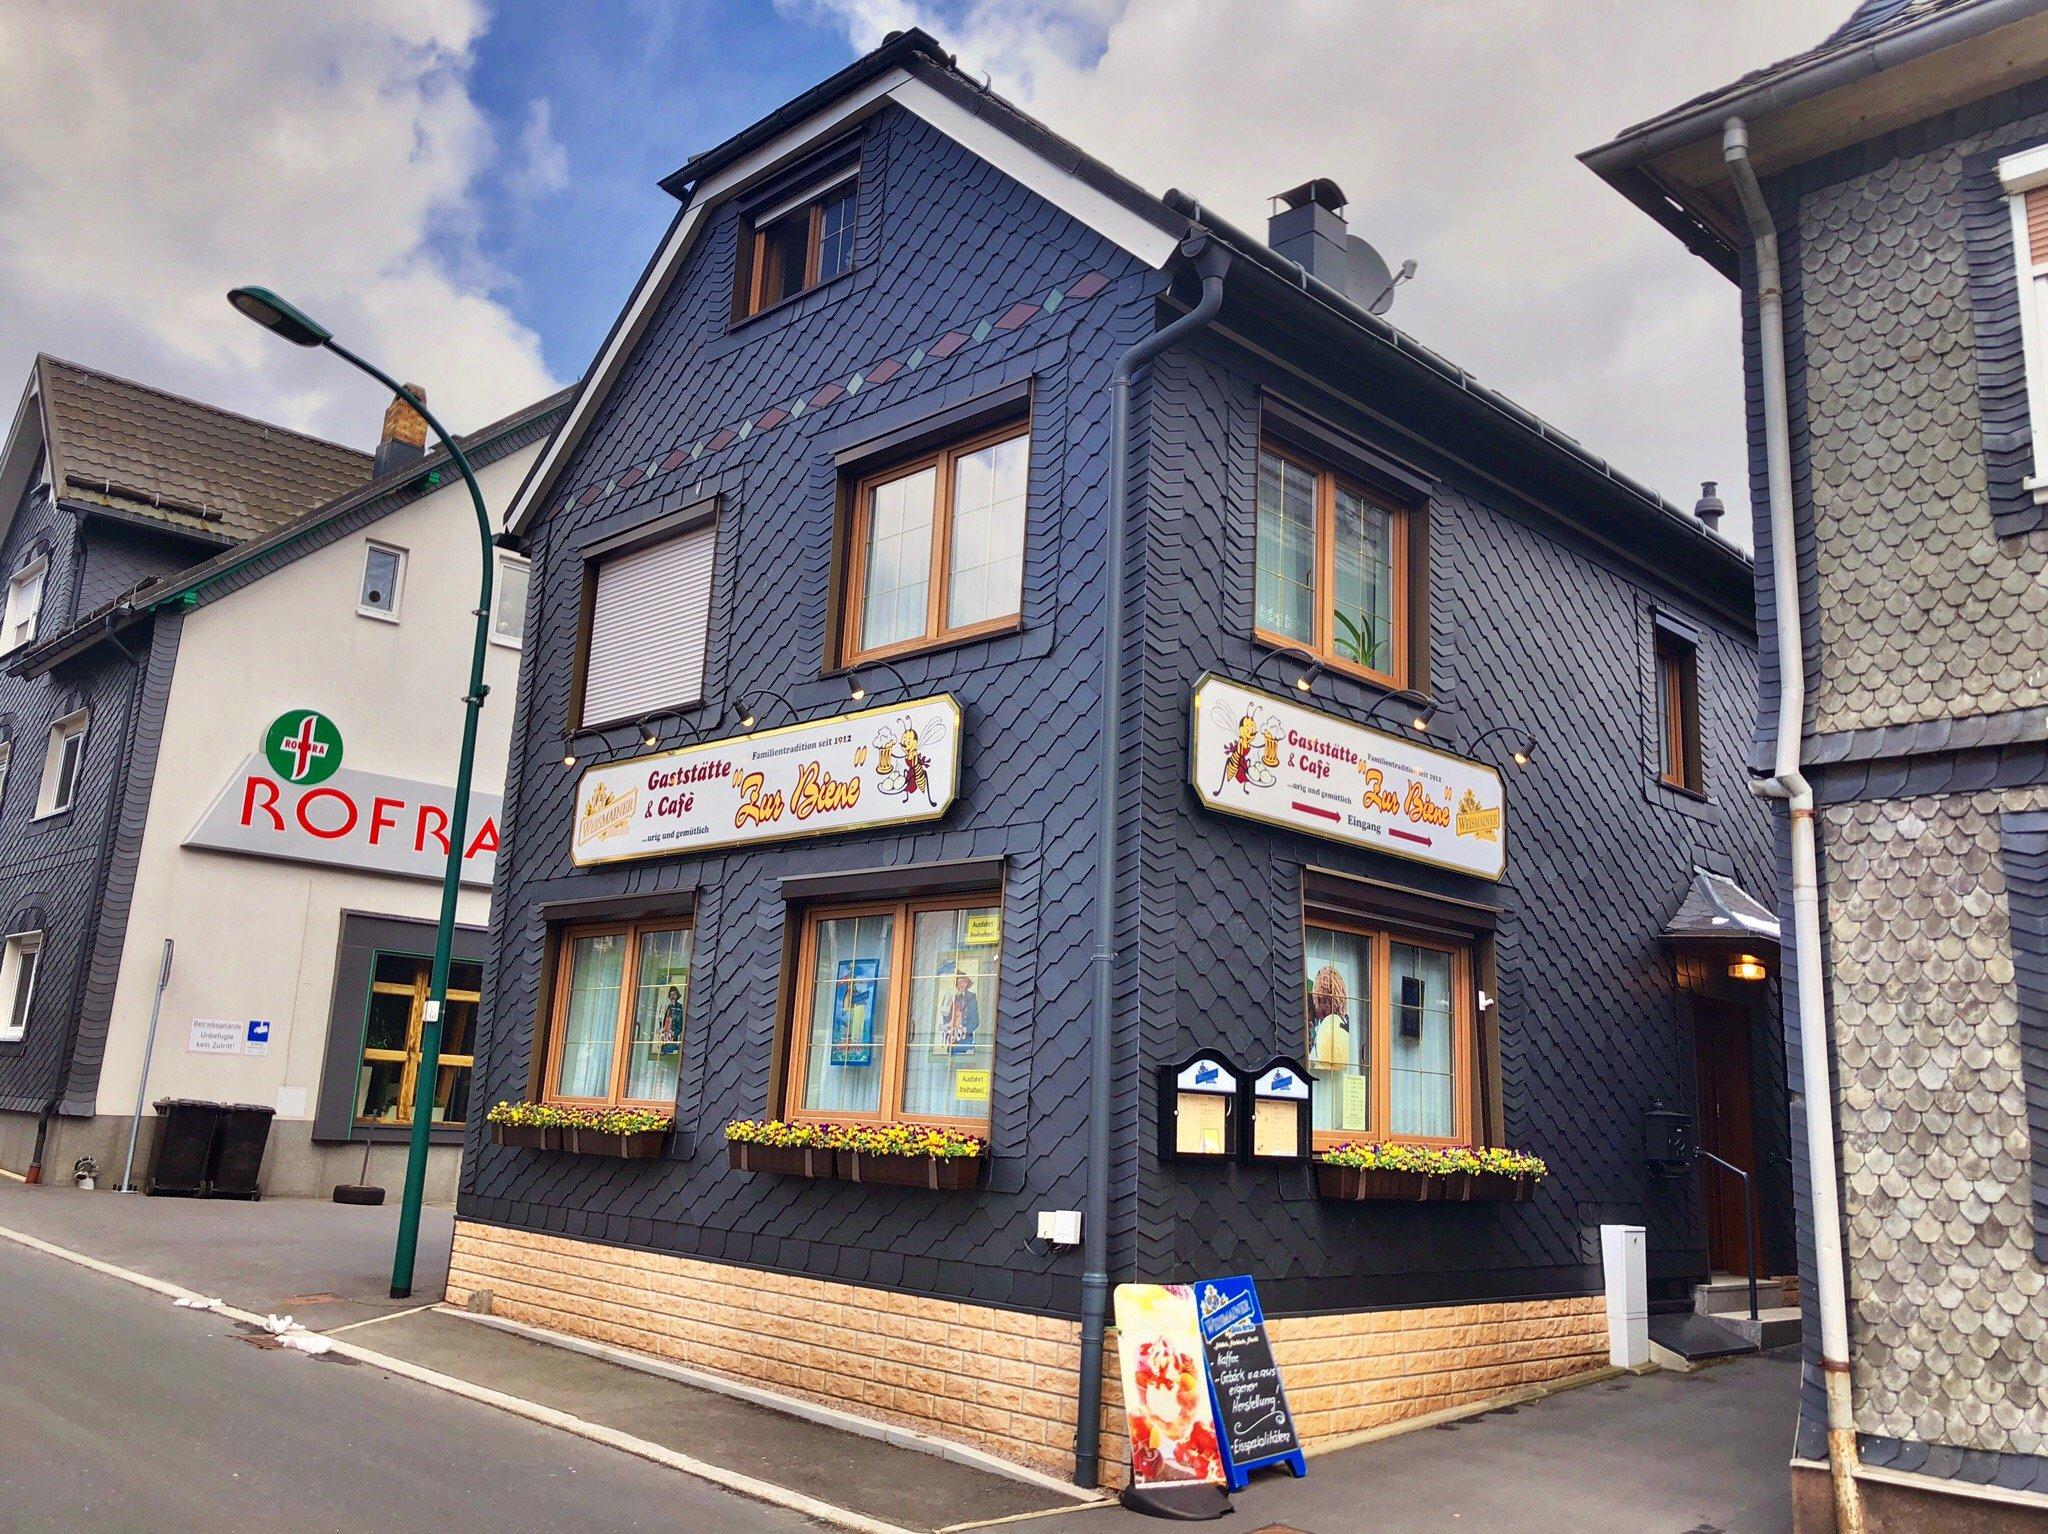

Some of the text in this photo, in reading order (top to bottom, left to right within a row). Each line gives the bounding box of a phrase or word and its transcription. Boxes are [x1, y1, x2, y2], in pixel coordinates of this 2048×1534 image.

[752, 735, 852, 760] Familientradition seit 1912
[1288, 729, 1359, 765] Gaststätte
[1287, 753, 1295, 767] &
[648, 759, 732, 791] Gaststätte
[1307, 787, 1320, 797] und
[1321, 790, 1352, 805] gemütlich
[239, 776, 500, 859] ROFRA
[644, 799, 654, 819] &
[662, 829, 675, 840] und
[676, 825, 710, 838] gemütlich
[1348, 814, 1382, 835] Eingang
[200, 1032, 234, 1041] Unbefugte
[1217, 1351, 1239, 1367] Kaffee
[1229, 1382, 1258, 1399] eigener
